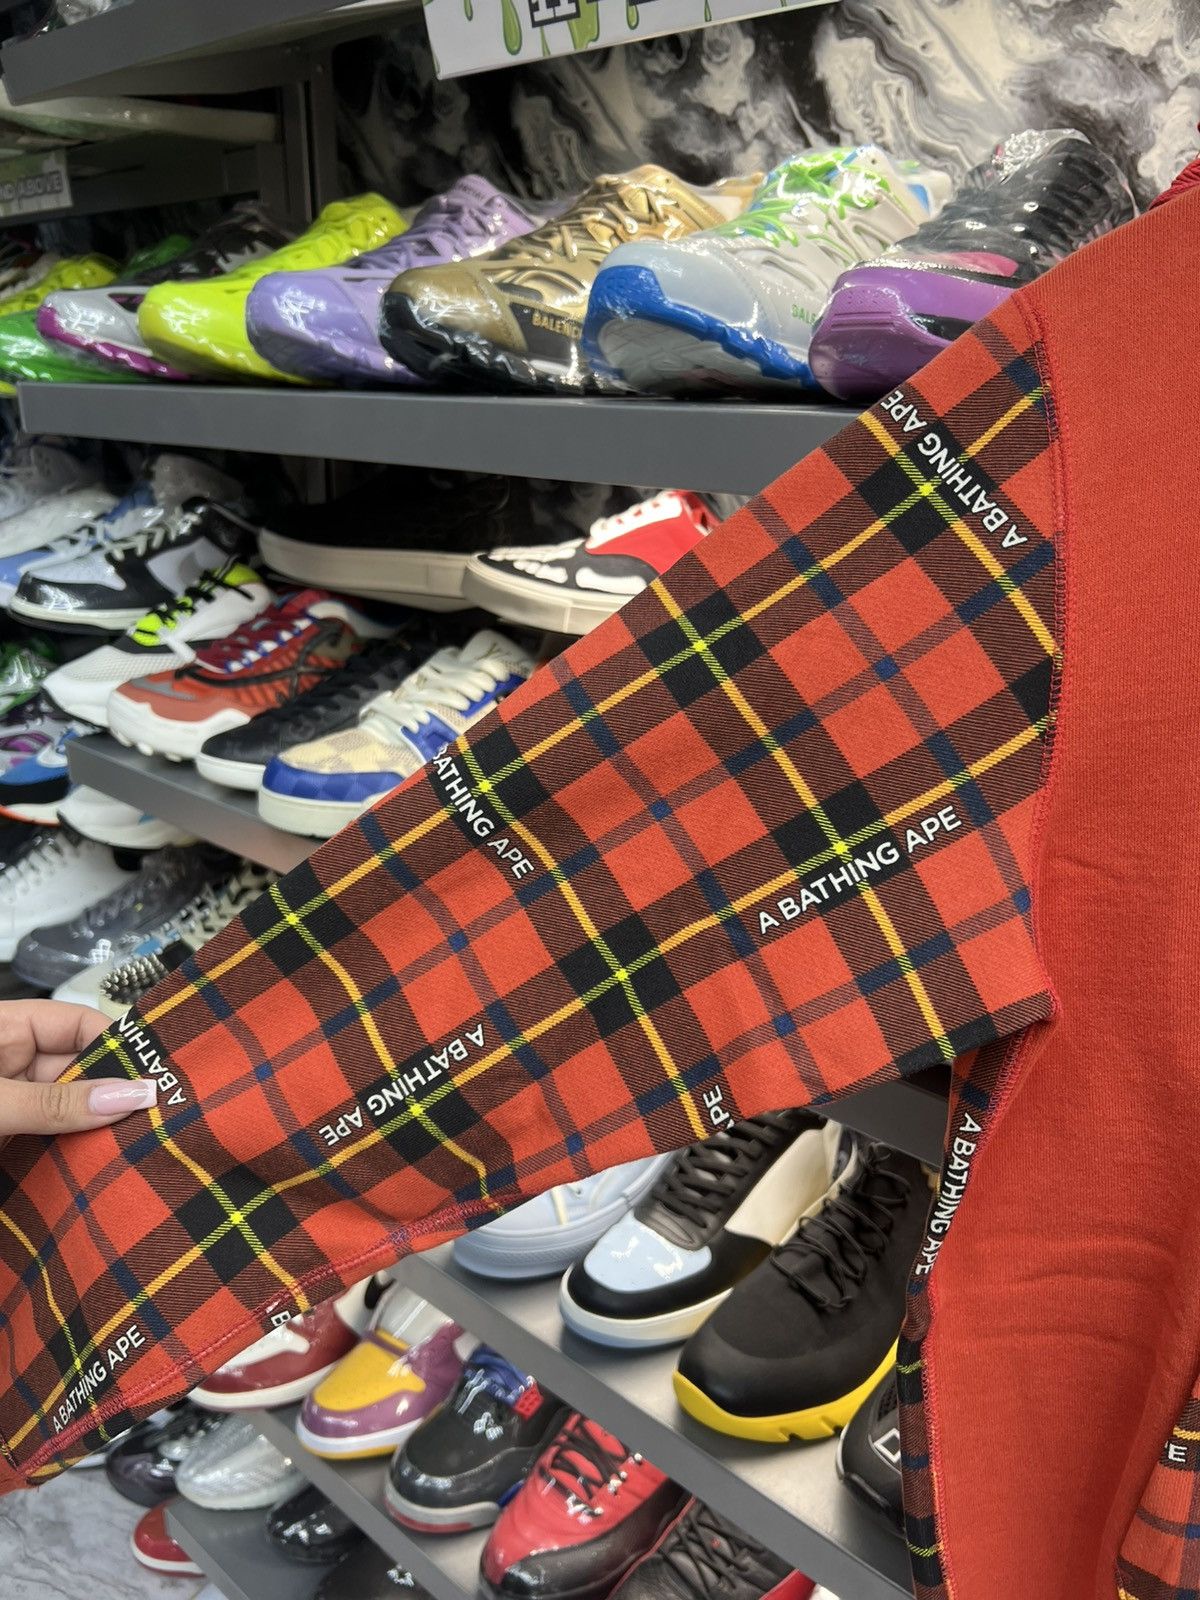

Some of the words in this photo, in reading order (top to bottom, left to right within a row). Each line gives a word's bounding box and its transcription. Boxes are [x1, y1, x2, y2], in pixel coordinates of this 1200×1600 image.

[880, 390, 928, 433] APE
[917, 432, 1009, 533] BATHING
[1001, 524, 1028, 548] A
[486, 838, 535, 880] APE
[758, 910, 780, 935] A
[777, 841, 900, 921] BATHING
[905, 805, 962, 853] APE
[465, 1023, 485, 1048] A
[167, 1087, 187, 1105] A
[366, 1038, 469, 1117] BATHING
[318, 1106, 364, 1146] APE
[959, 1112, 982, 1133] A
[929, 1136, 977, 1234] BATHING
[914, 1235, 944, 1276] APE
[52, 1415, 64, 1434] A
[58, 1360, 107, 1426] BATHING
[107, 1324, 146, 1370] APE
